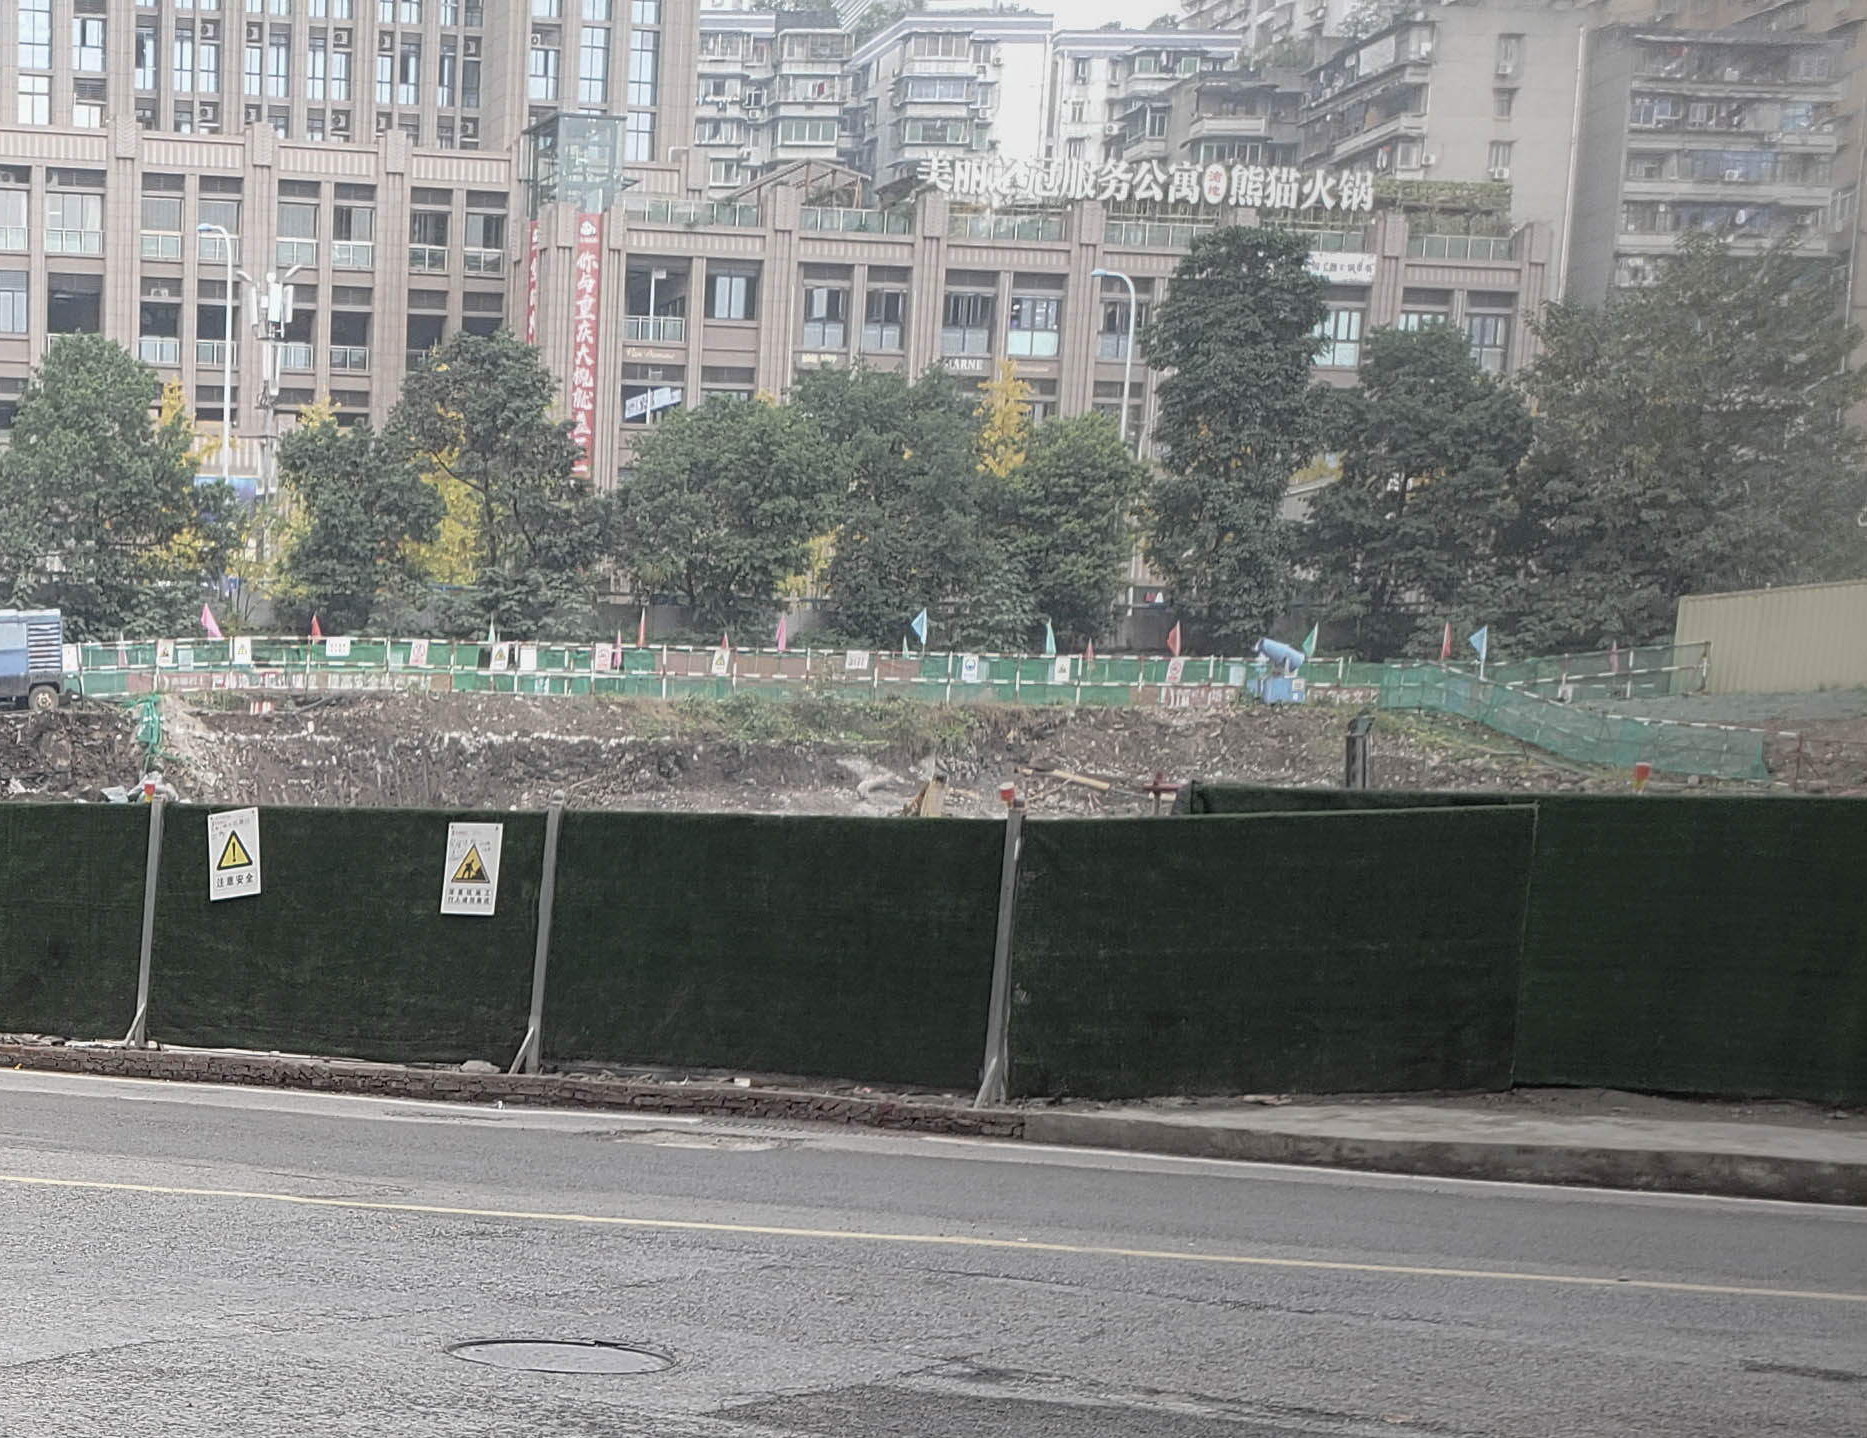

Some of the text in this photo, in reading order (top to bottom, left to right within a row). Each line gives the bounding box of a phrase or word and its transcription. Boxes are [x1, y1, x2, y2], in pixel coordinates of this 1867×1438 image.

[1229, 164, 1375, 212] 熊猫火锅
[217, 873, 254, 888] 注意安全
